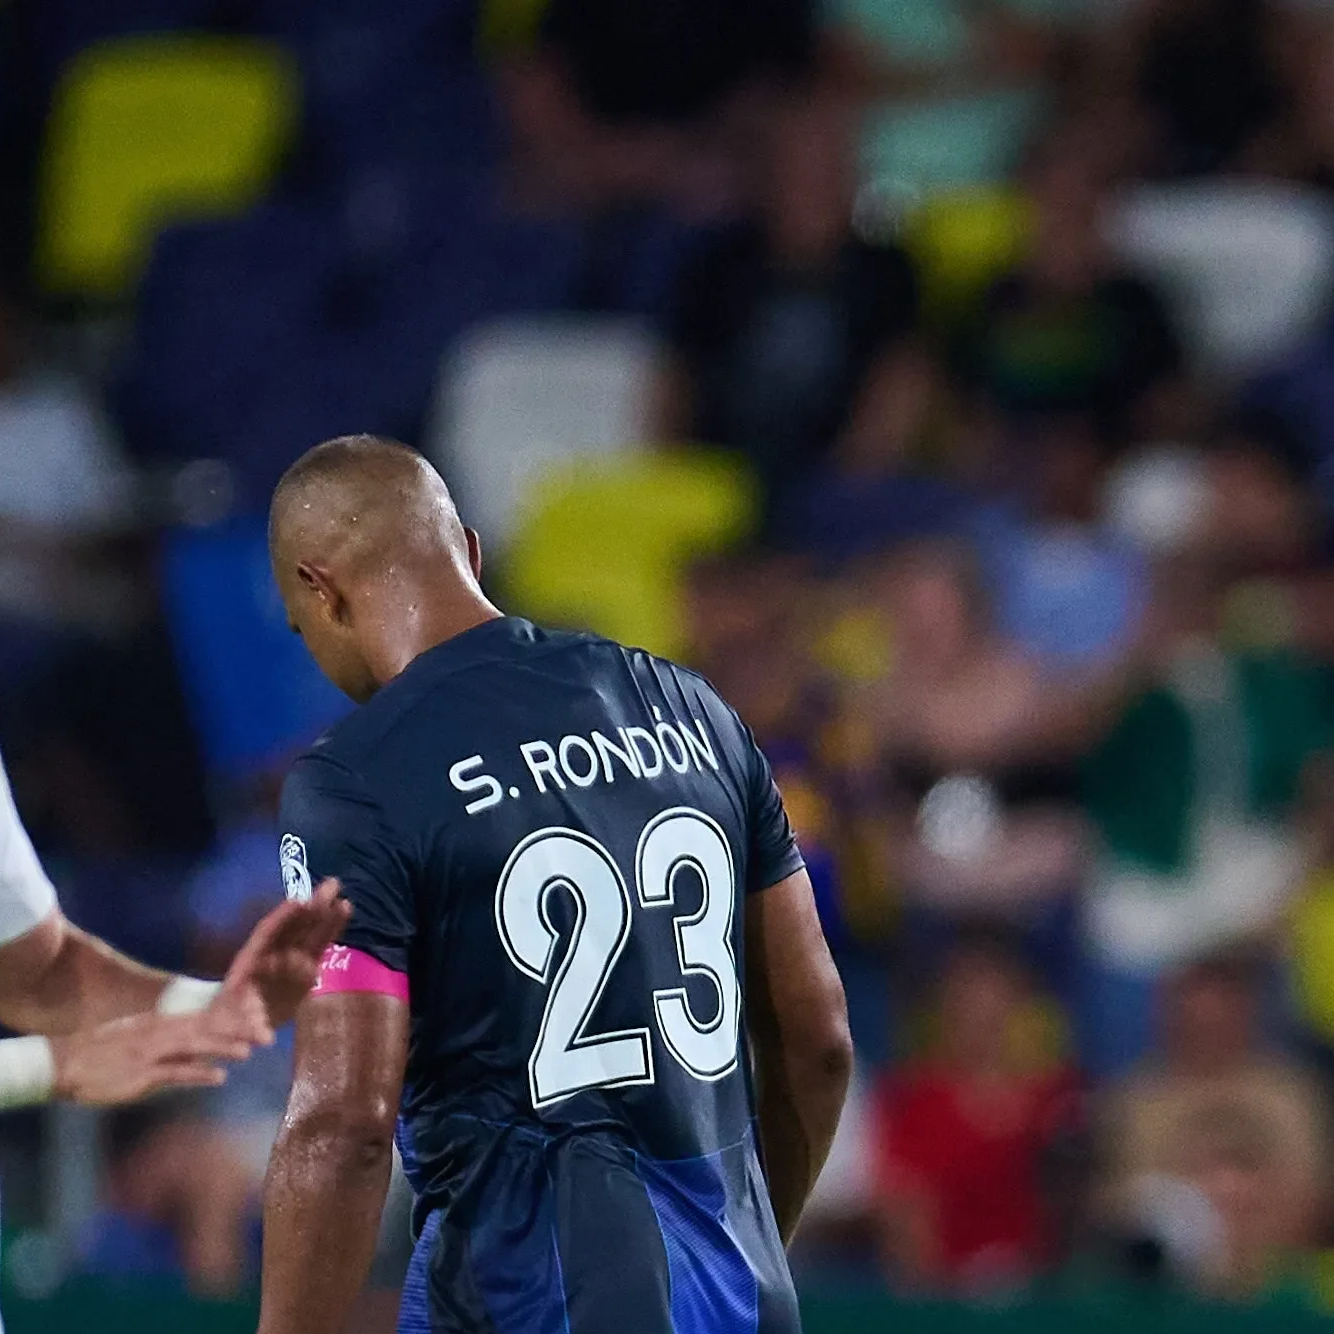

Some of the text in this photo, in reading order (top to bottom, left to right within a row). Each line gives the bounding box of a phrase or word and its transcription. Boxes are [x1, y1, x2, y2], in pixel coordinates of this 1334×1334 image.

[448, 706, 719, 815] S. RONDÓN
[494, 806, 741, 1109] 23
